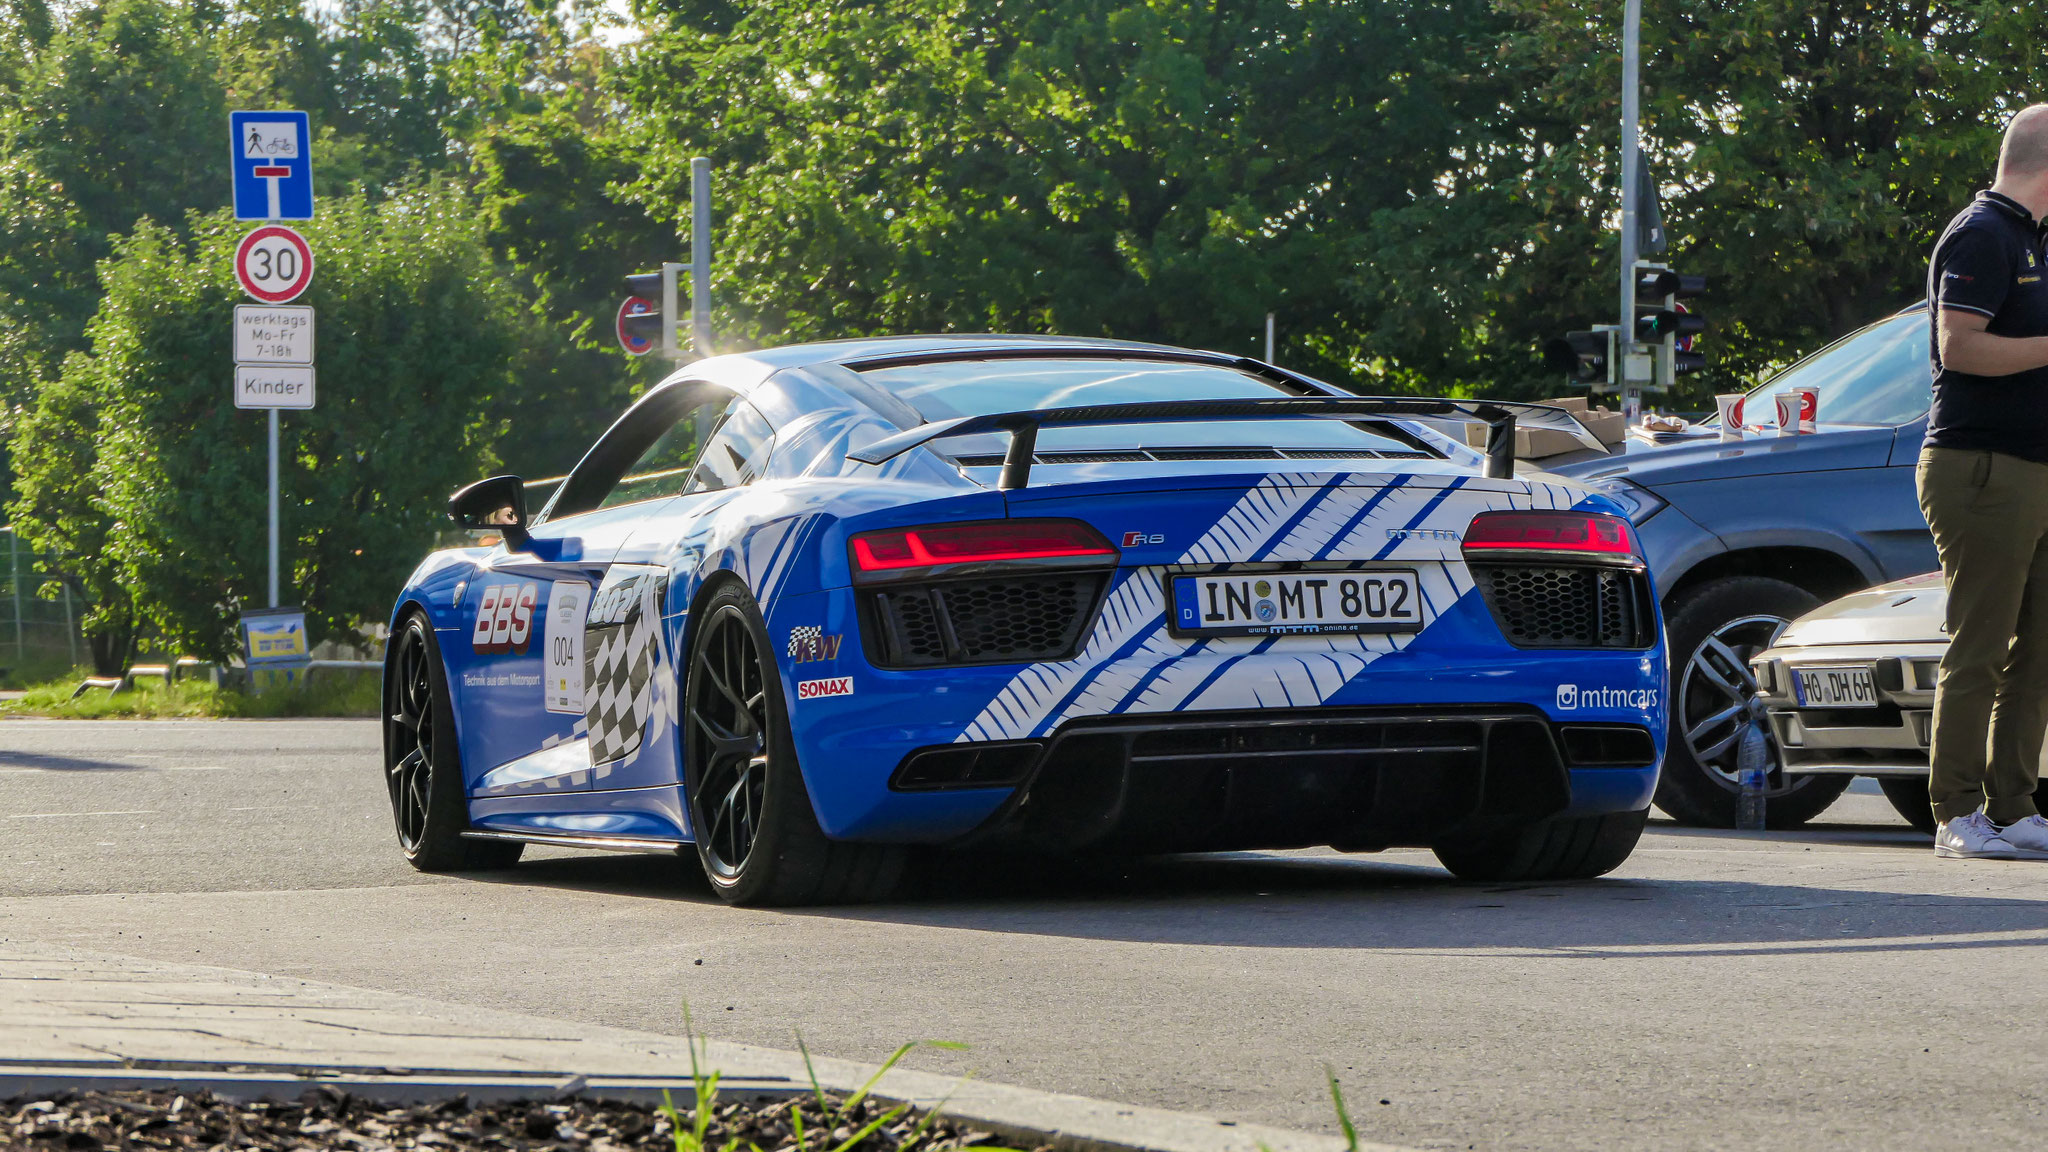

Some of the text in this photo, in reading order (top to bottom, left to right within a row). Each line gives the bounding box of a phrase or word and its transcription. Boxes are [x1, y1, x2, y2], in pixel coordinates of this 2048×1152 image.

[253, 248, 295, 281] 30
[242, 313, 307, 329] werktags
[252, 329, 294, 341] Mo-Fr
[256, 345, 292, 357] 7-18h
[245, 378, 304, 395] Kinder
[1184, 579, 1412, 622] D IN MT 802
[473, 582, 538, 653] BBS
[554, 636, 574, 667] 004
[795, 633, 843, 664] KW
[463, 674, 485, 687] Technik
[486, 676, 497, 687] aus
[497, 675, 510, 687] dem
[509, 673, 541, 688] Motorsport
[799, 678, 849, 698] SONAX
[1800, 672, 1875, 702] HO DH 6H
[1581, 685, 1658, 710] mtmcars
